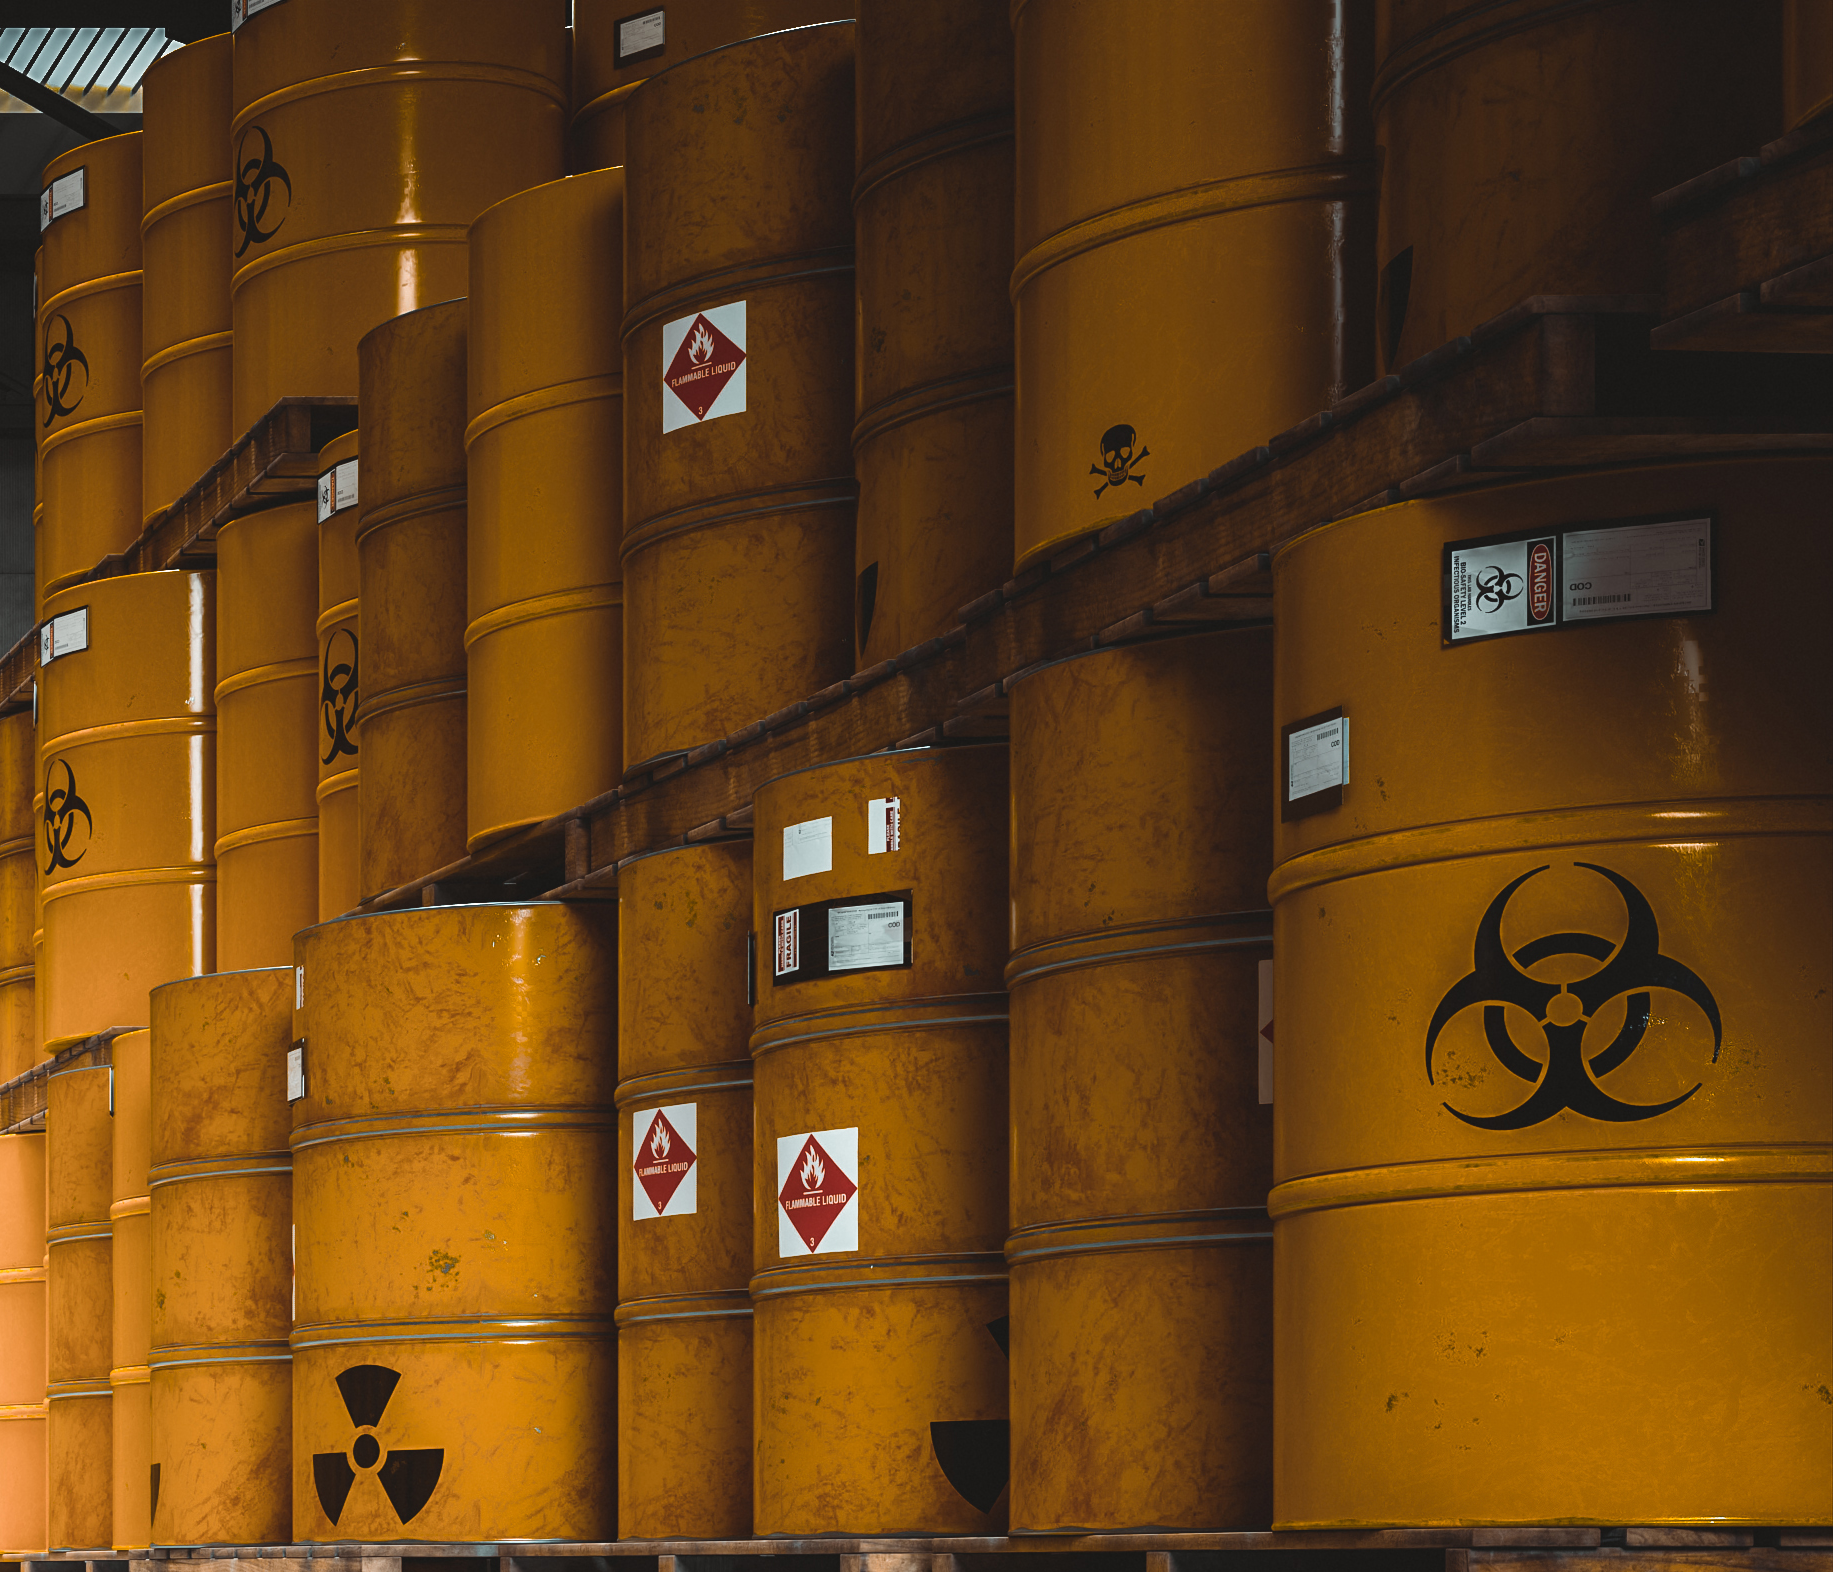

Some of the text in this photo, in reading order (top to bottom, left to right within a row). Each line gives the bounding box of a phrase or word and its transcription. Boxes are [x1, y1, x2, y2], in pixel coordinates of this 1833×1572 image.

[671, 361, 736, 388] FLAMMABLE LIQUID
[698, 406, 703, 415] 3
[1534, 553, 1546, 613] DANGER
[1569, 582, 1592, 591] COD
[639, 1161, 688, 1177] FLAMMABLE LIQUID
[658, 1201, 662, 1210] 3
[785, 1193, 847, 1210] FLAMMABLE LIQUID
[809, 1237, 815, 1247] 3
